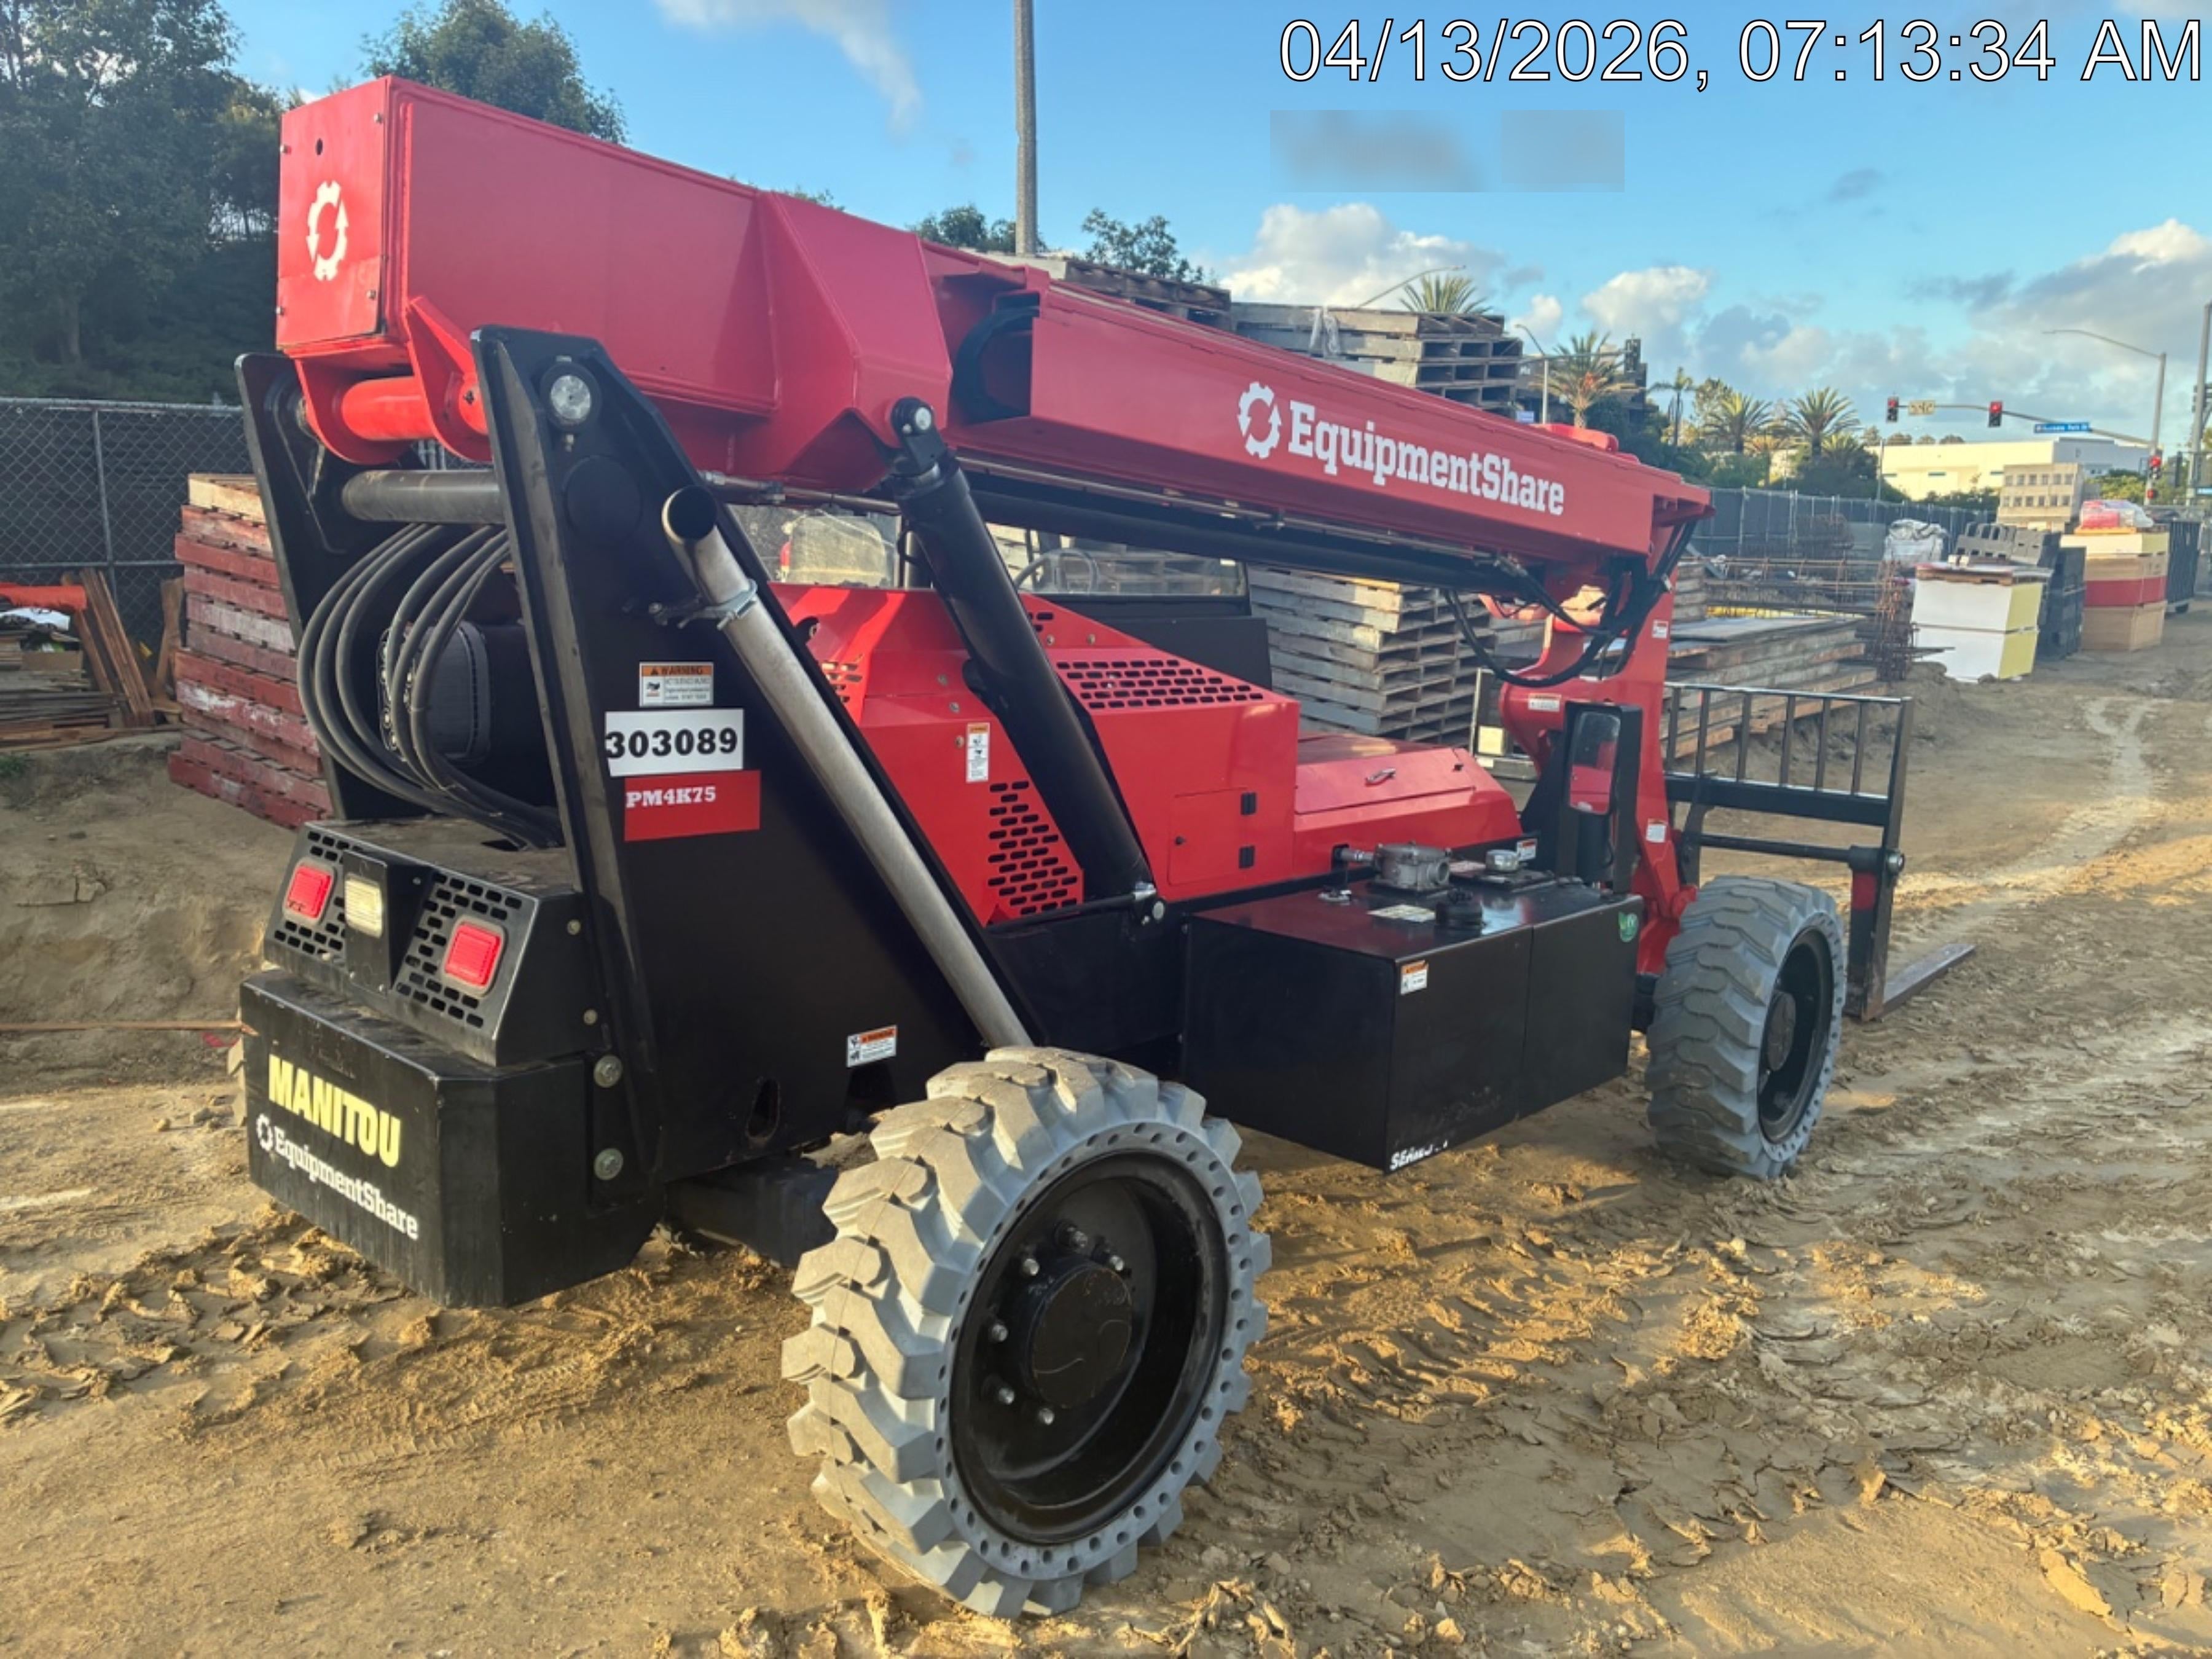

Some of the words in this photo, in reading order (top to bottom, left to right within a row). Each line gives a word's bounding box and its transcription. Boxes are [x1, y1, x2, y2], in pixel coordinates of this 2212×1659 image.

[1288, 401, 1564, 516] EquipmentShare
[605, 727, 738, 759] 303089
[626, 786, 716, 809] PM4K75
[269, 1053, 401, 1167] MANITOU
[273, 1125, 419, 1241] EquipmentShare
